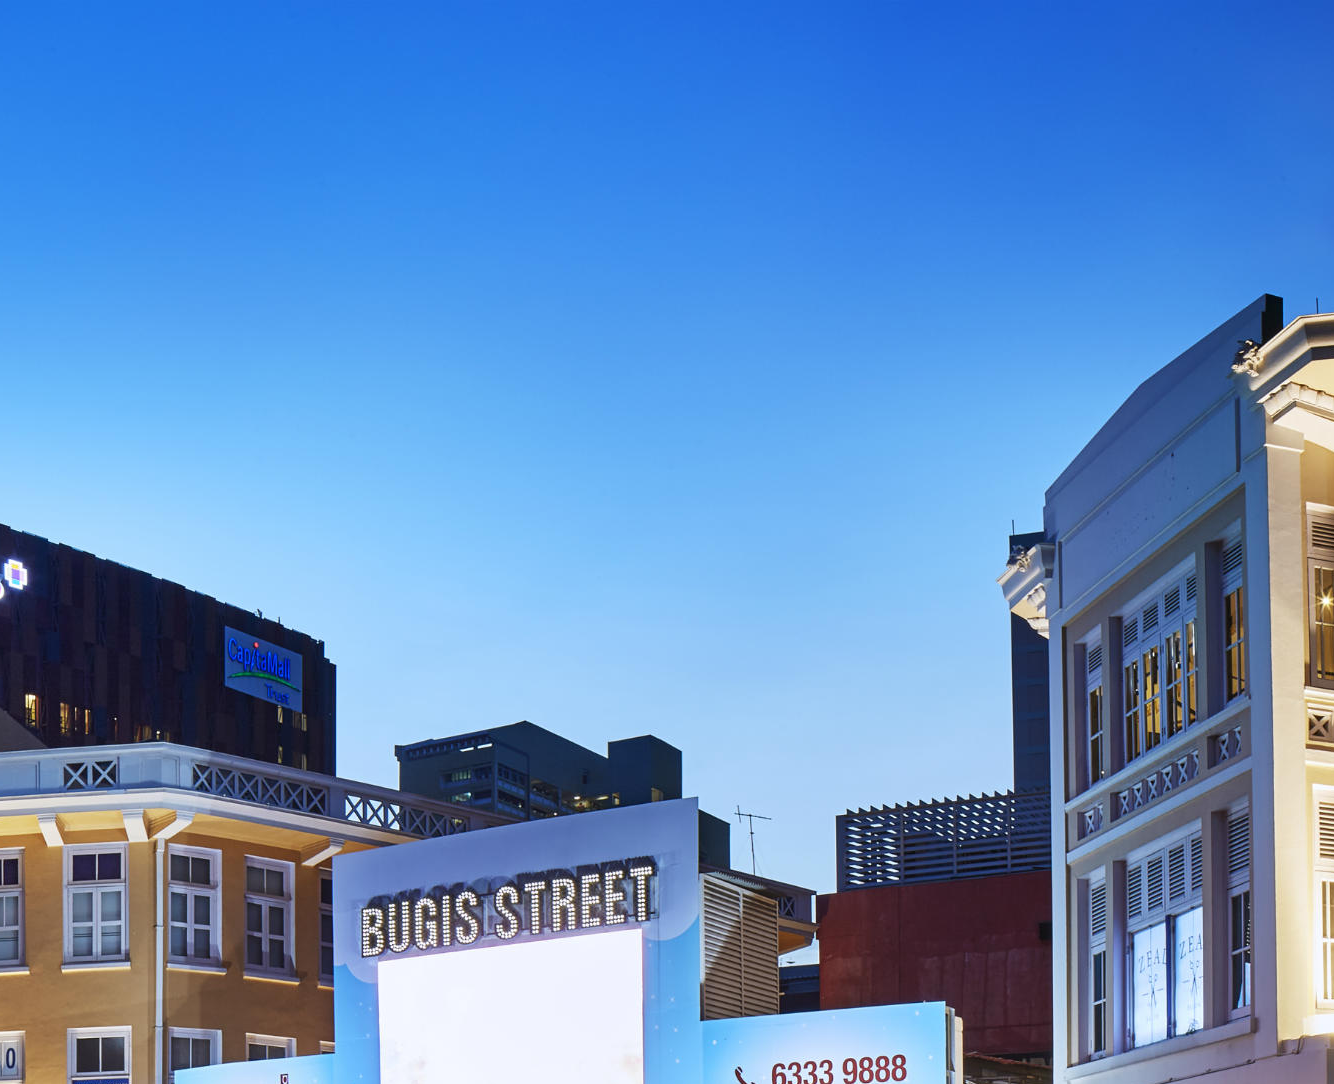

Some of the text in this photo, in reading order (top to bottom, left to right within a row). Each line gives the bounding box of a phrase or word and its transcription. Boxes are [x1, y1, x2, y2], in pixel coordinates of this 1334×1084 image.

[228, 637, 291, 681] CapitaMall
[264, 683, 290, 705] Trust
[361, 866, 653, 957] BUGIS STREET
[842, 1054, 907, 1084] 9888
